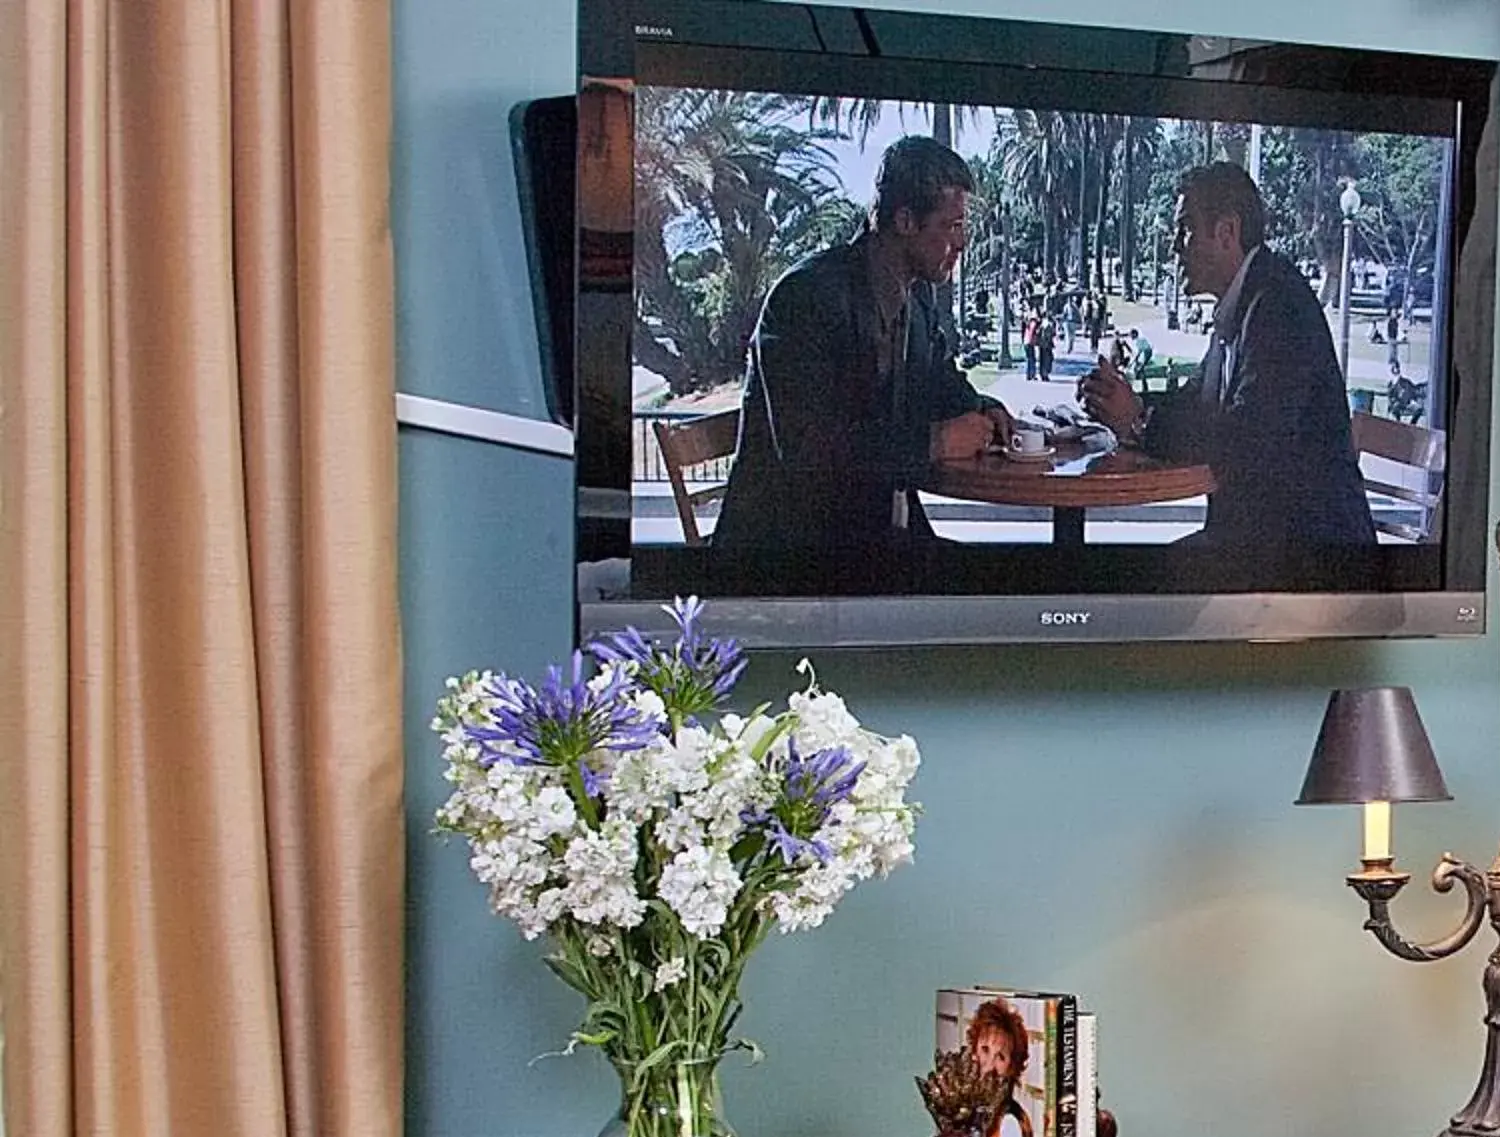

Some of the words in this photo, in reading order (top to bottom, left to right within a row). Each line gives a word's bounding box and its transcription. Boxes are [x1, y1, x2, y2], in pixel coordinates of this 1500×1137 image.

[1041, 612, 1090, 624] SONY
[1063, 1004, 1075, 1025] THE
[1063, 1027, 1075, 1087] TESTAMENT
